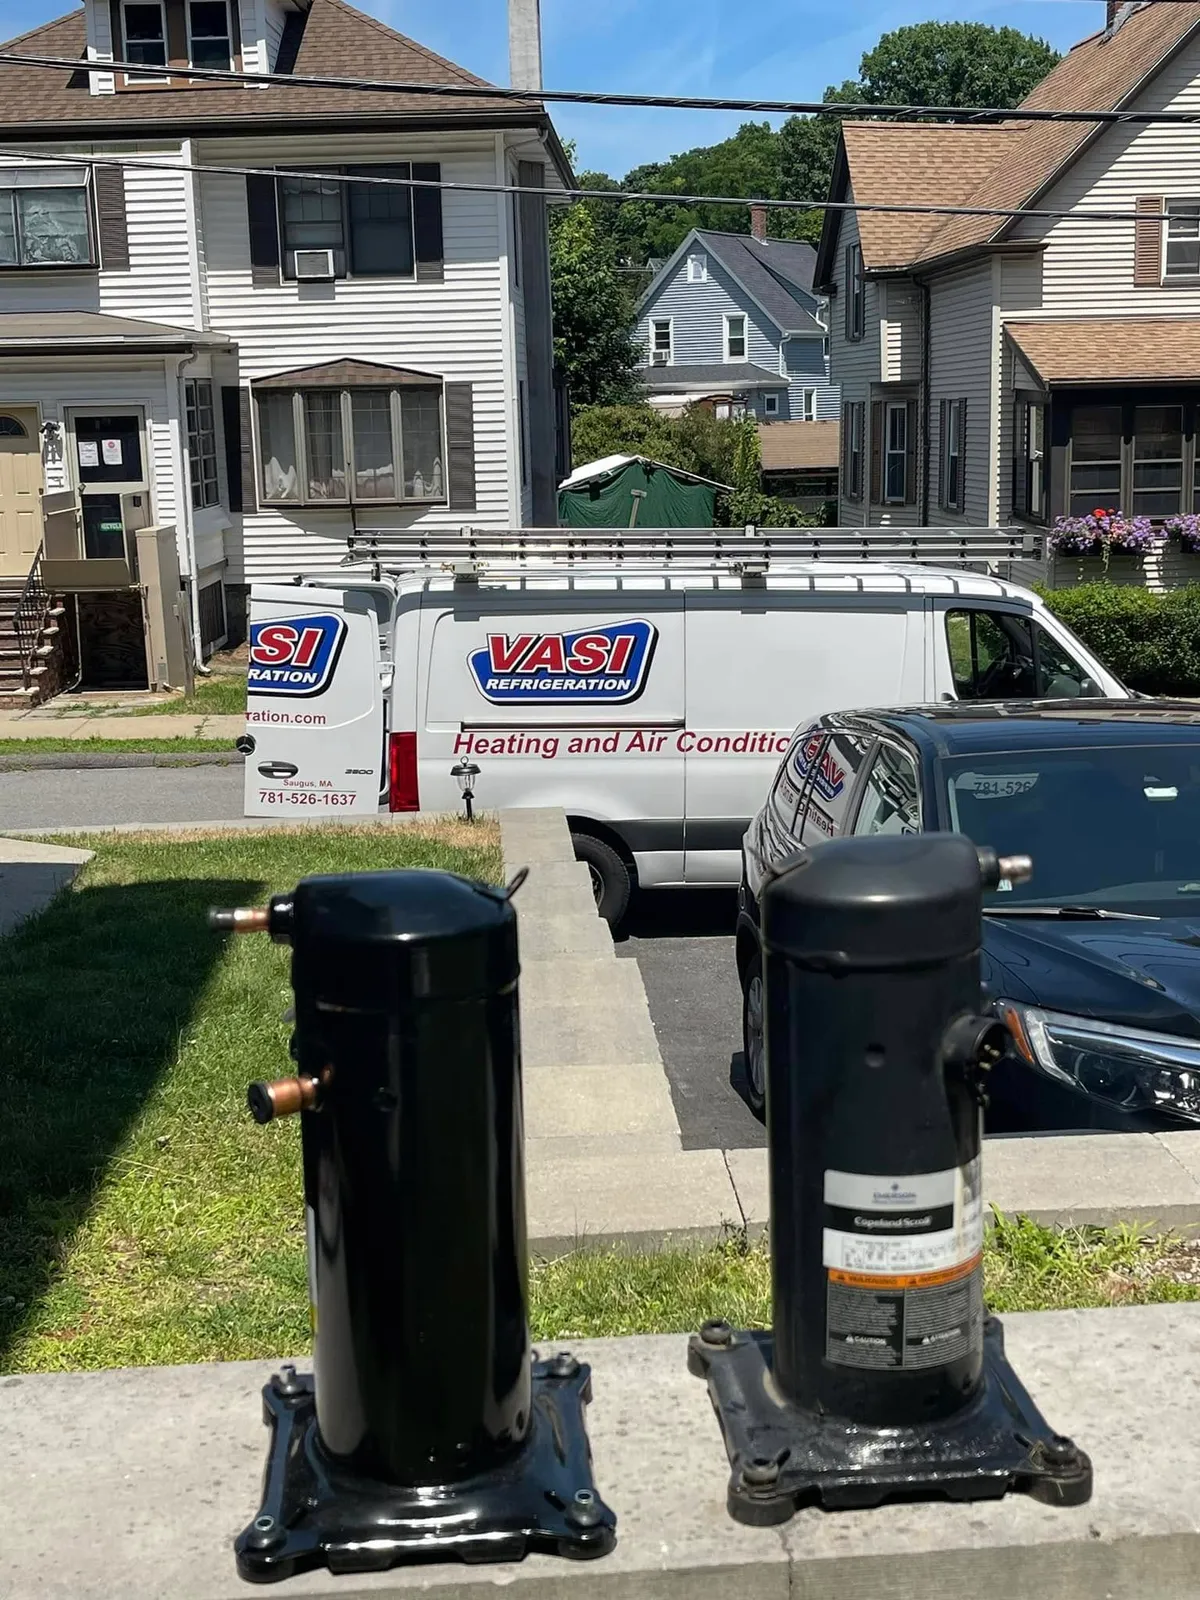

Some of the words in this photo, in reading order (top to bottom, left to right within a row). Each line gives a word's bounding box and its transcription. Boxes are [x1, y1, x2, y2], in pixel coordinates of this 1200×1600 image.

[487, 634, 636, 674] VASI
[247, 668, 318, 684] RATION
[486, 678, 631, 691] REFRIGERATION
[453, 733, 559, 759] Heating
[568, 732, 620, 753] and
[625, 731, 668, 752] Air
[283, 779, 317, 788] Saugus,
[319, 780, 333, 788] MA
[259, 791, 357, 805] 781-526-1637
[854, 1216, 902, 1229] Copeland
[854, 1335, 887, 1346] CAUTION
